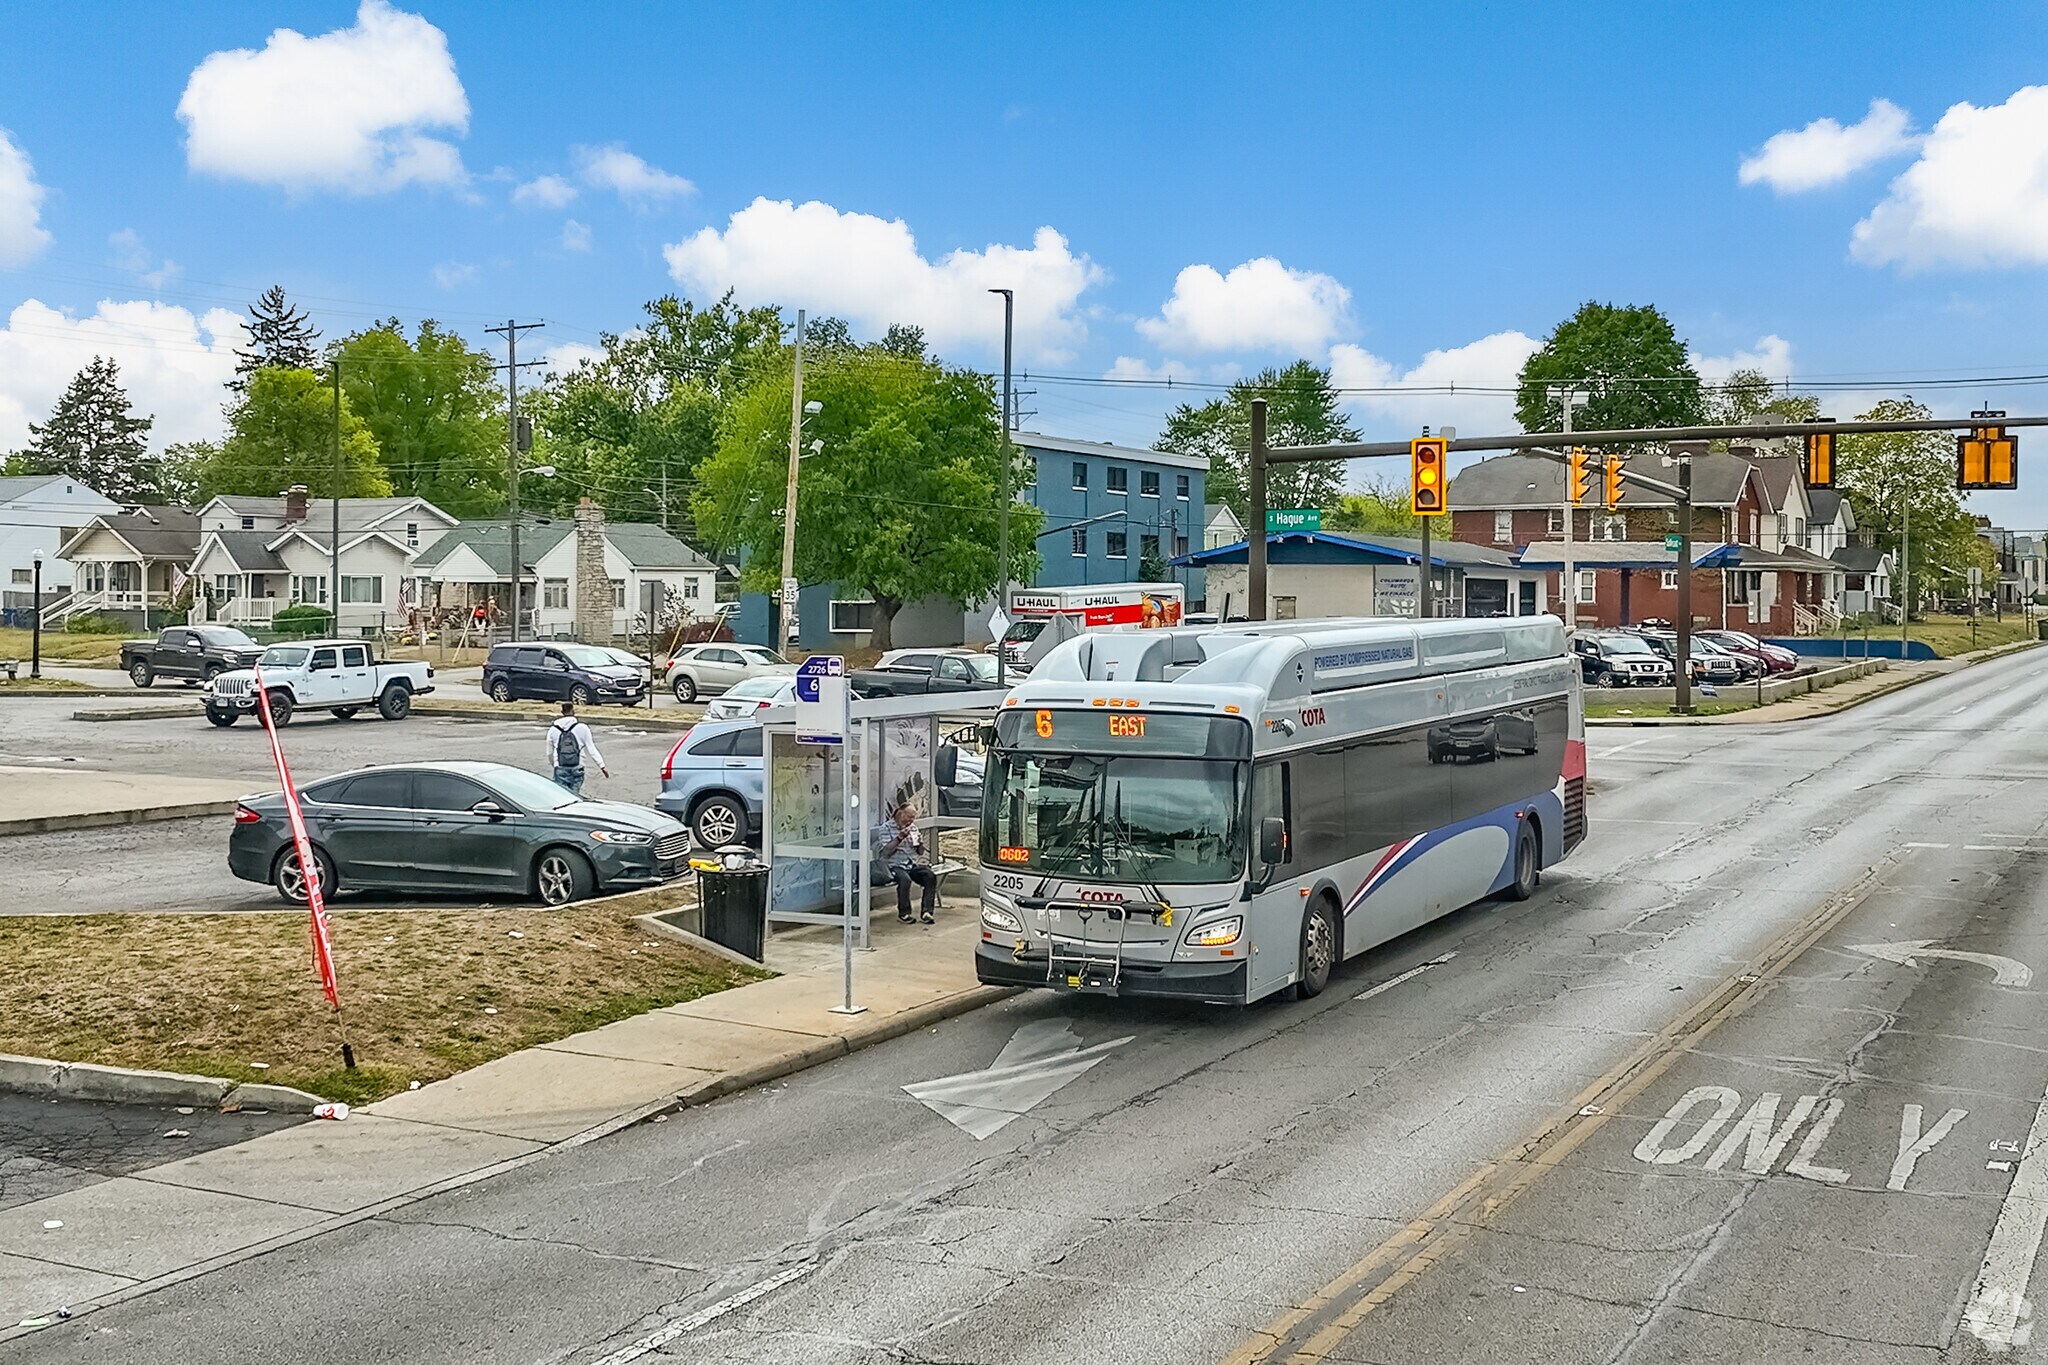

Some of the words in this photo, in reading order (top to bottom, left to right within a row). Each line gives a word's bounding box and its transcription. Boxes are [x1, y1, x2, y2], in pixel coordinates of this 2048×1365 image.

[1276, 512, 1305, 527] Hague
[785, 590, 796, 600] 35
[1314, 655, 1340, 669] POWERED
[1348, 650, 1380, 665] COMPRESSED
[1381, 648, 1402, 660] NATURAL
[1402, 646, 1413, 658] GAS
[808, 665, 827, 674] 2726
[810, 679, 819, 692] 6
[1035, 709, 1054, 738] 6
[1301, 708, 1326, 727] COTA
[1108, 715, 1147, 737] EAST
[1271, 719, 1285, 733] 2205
[1000, 847, 1030, 862] 0602
[993, 874, 1024, 890] 2205
[1080, 890, 1124, 902] COTA
[1632, 1085, 1971, 1192] ONLY
